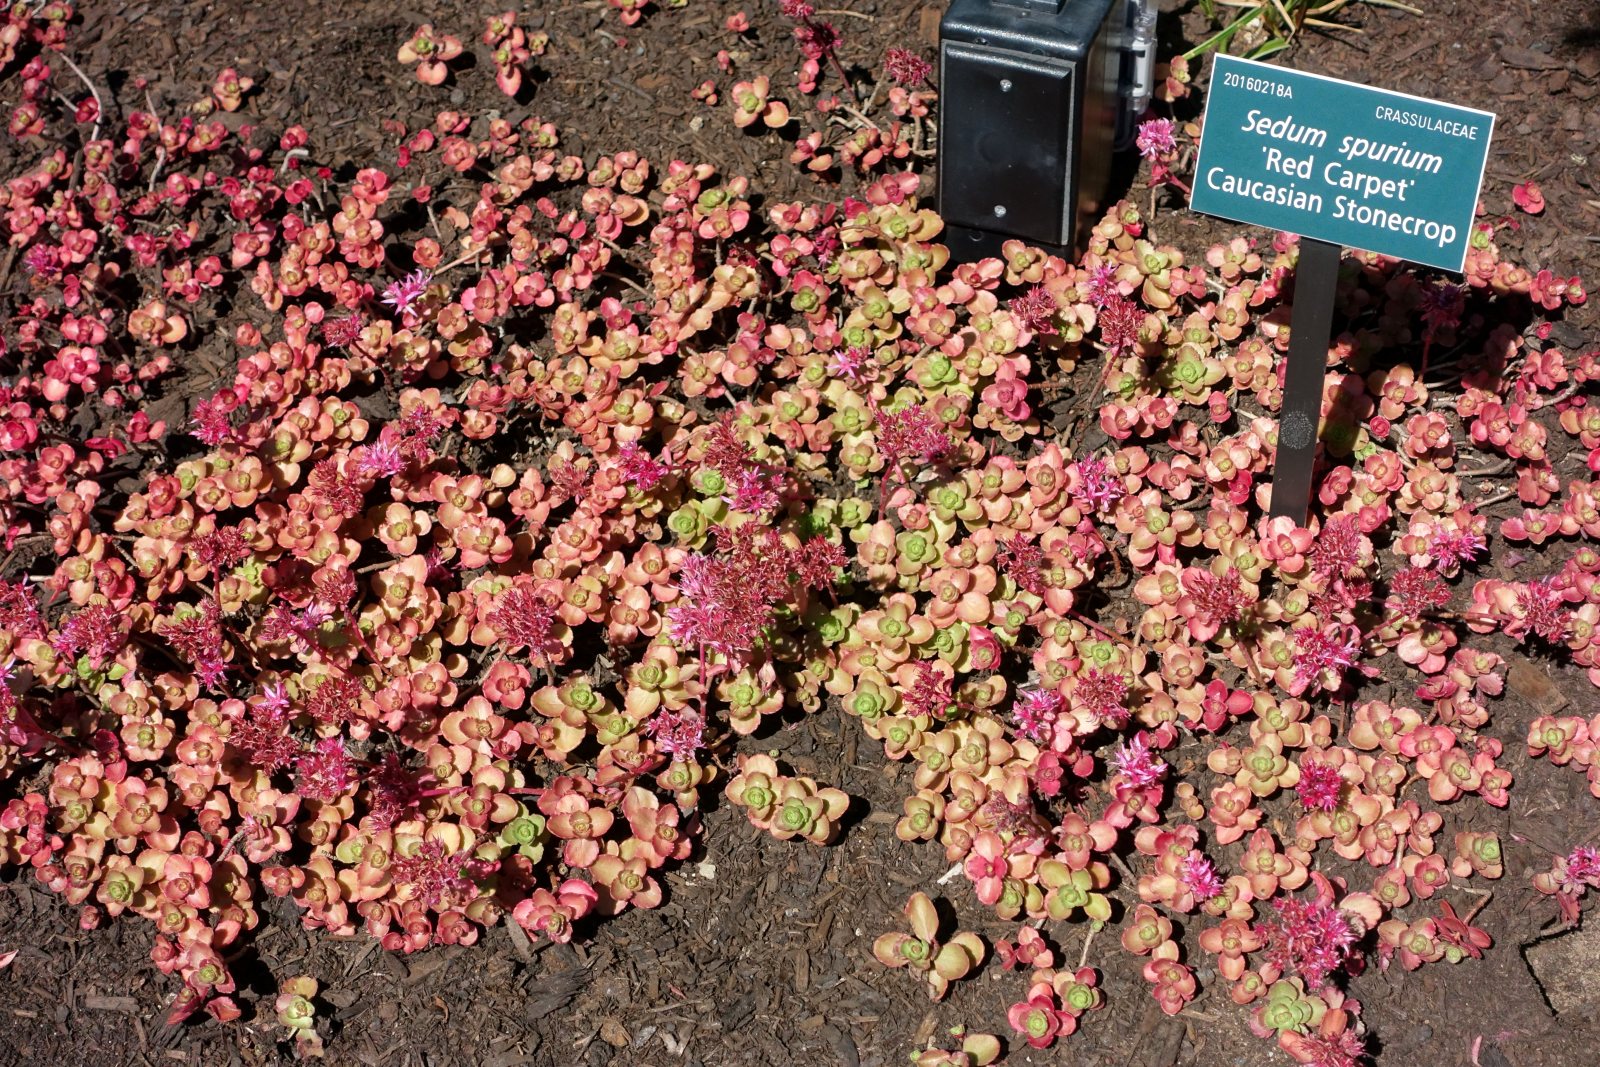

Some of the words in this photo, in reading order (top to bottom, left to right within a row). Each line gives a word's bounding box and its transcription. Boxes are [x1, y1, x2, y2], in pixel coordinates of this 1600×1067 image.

[1223, 72, 1293, 99] 20160218A
[1241, 109, 1327, 148] Sedum
[1338, 135, 1443, 174] spurium
[1375, 105, 1479, 140] CRASSULACEAE
[1262, 146, 1314, 180] 'Red
[1323, 162, 1415, 202] Carpet'
[1206, 166, 1323, 214] Caucasian
[1332, 195, 1457, 248] Stonecrop
